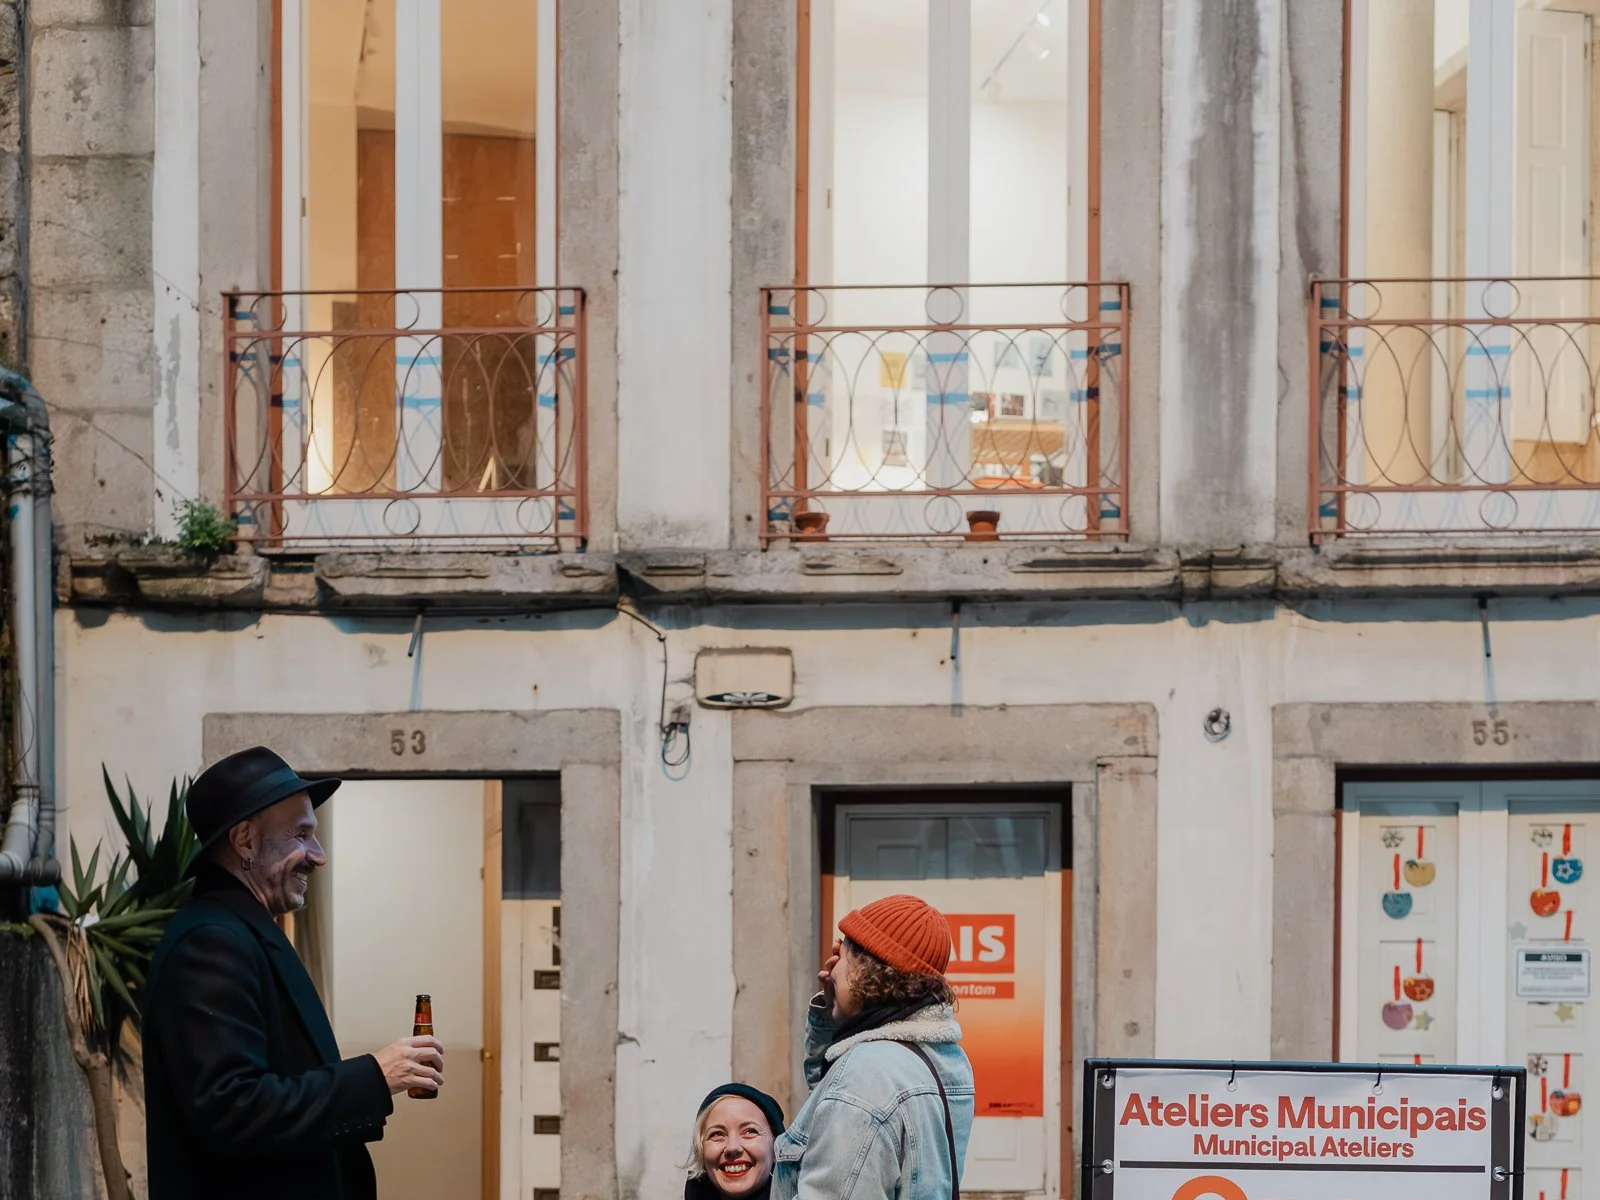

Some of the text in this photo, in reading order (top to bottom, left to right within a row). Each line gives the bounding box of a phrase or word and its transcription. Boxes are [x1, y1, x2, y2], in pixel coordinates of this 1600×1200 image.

[390, 729, 426, 756] 53
[1472, 720, 1509, 746] 55
[949, 925, 1006, 962] IS
[1119, 1091, 1488, 1139] Ateliers Municipais
[1193, 1134, 1415, 1162] Municipal Ateliers
